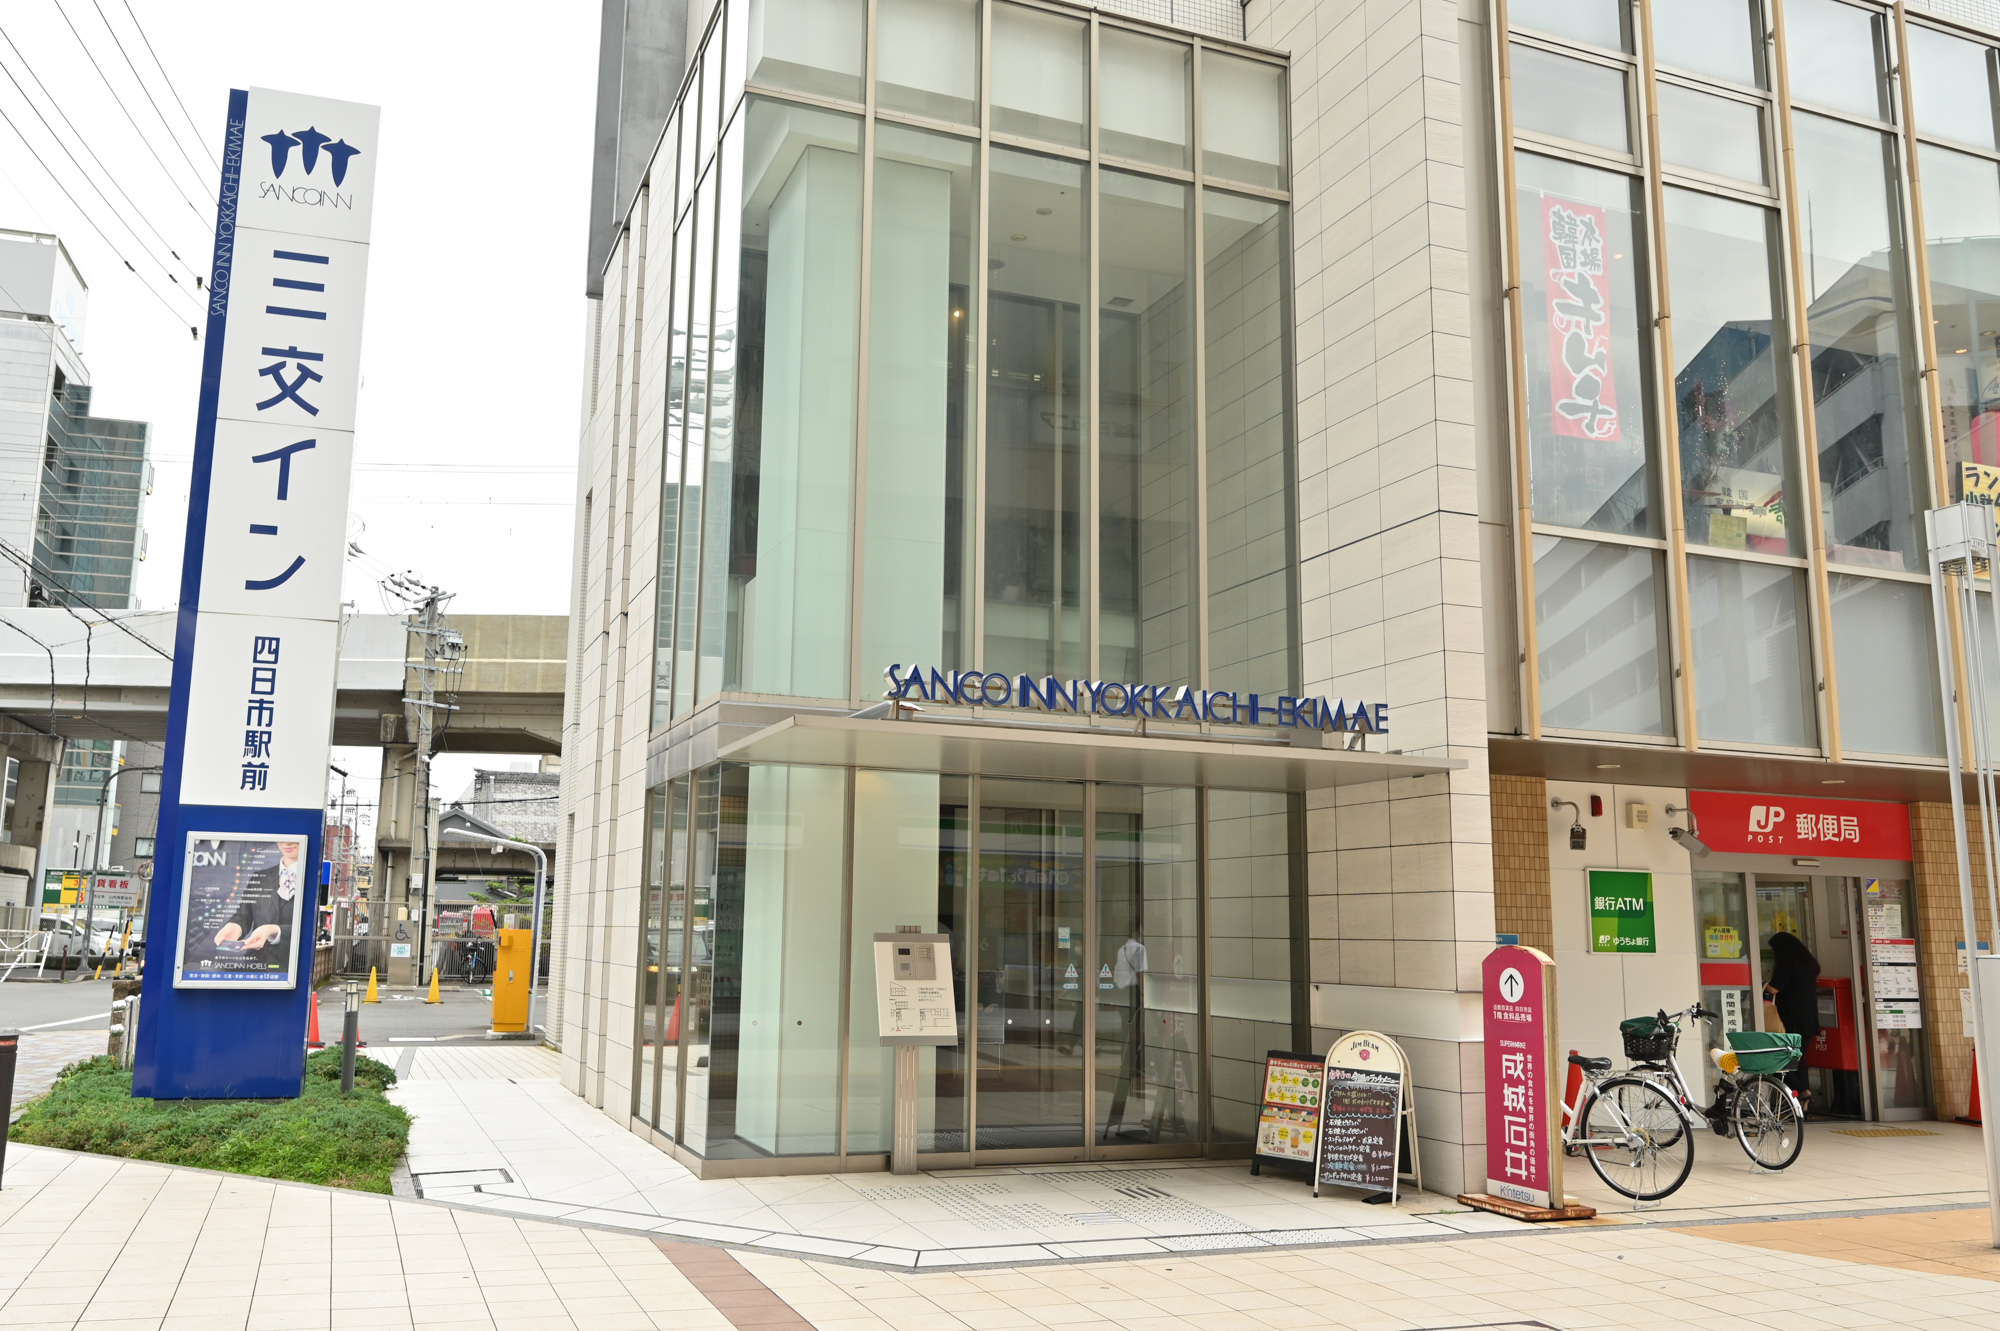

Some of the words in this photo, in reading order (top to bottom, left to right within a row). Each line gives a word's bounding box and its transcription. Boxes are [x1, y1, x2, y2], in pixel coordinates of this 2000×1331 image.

[218, 118, 244, 240] YOKKAICHI-EKIMAE
[216, 243, 232, 267] INN
[211, 269, 229, 316] SANCO
[245, 250, 329, 591] 三交イン
[240, 636, 280, 791] 四日市駅前
[886, 663, 1011, 705] SANCO
[1018, 673, 1078, 714] INN
[1082, 680, 1389, 734] YOKKAICHI-EKIMAE
[1747, 834, 1784, 844] POST
[1796, 813, 1860, 843] 郵便局
[1594, 896, 1644, 911] 銀行ATM
[1613, 936, 1650, 946] ゆうちょ銀行
[1502, 1052, 1528, 1181] 成城石井
[1526, 1053, 1536, 1183] 世界の食品を世界の街角の価格で
